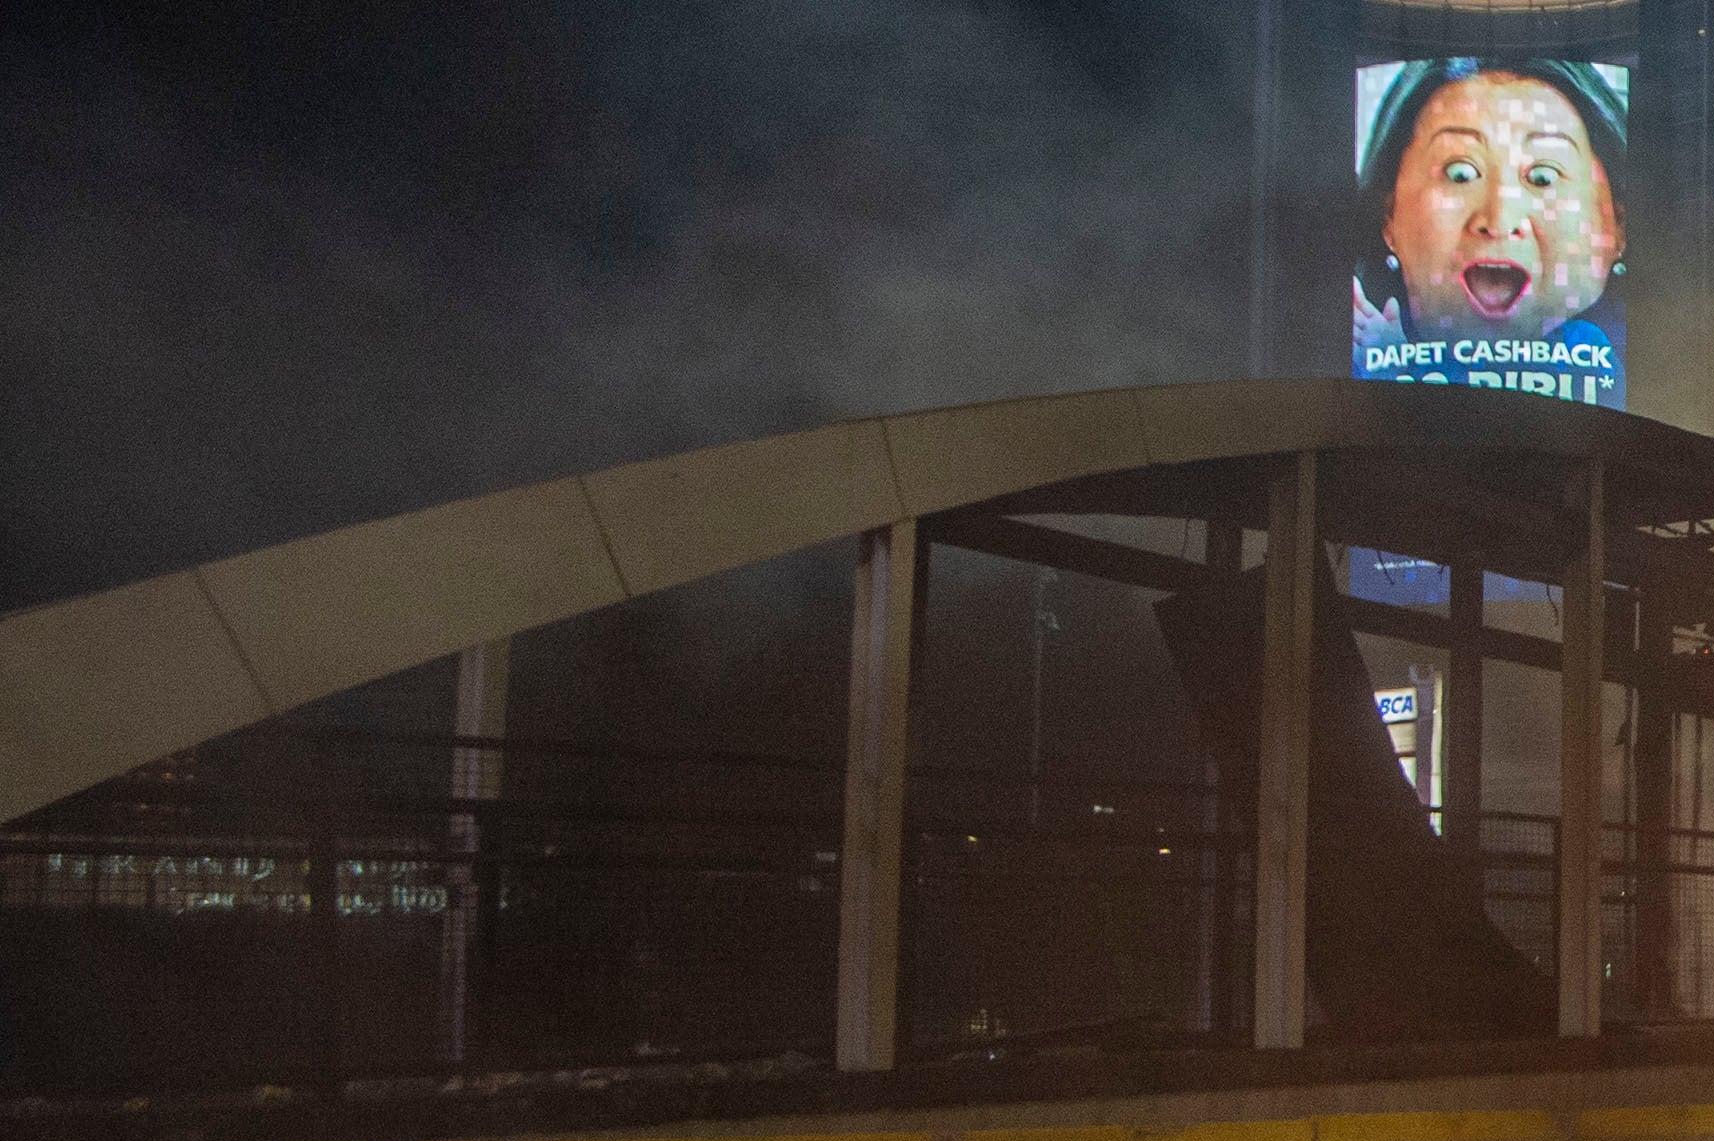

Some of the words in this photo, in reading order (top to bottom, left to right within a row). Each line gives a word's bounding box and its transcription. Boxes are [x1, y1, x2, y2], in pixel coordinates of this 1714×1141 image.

[1366, 341, 1447, 372] DAPET
[1453, 339, 1612, 368] CASHBACK
[1379, 695, 1414, 715] BCA
